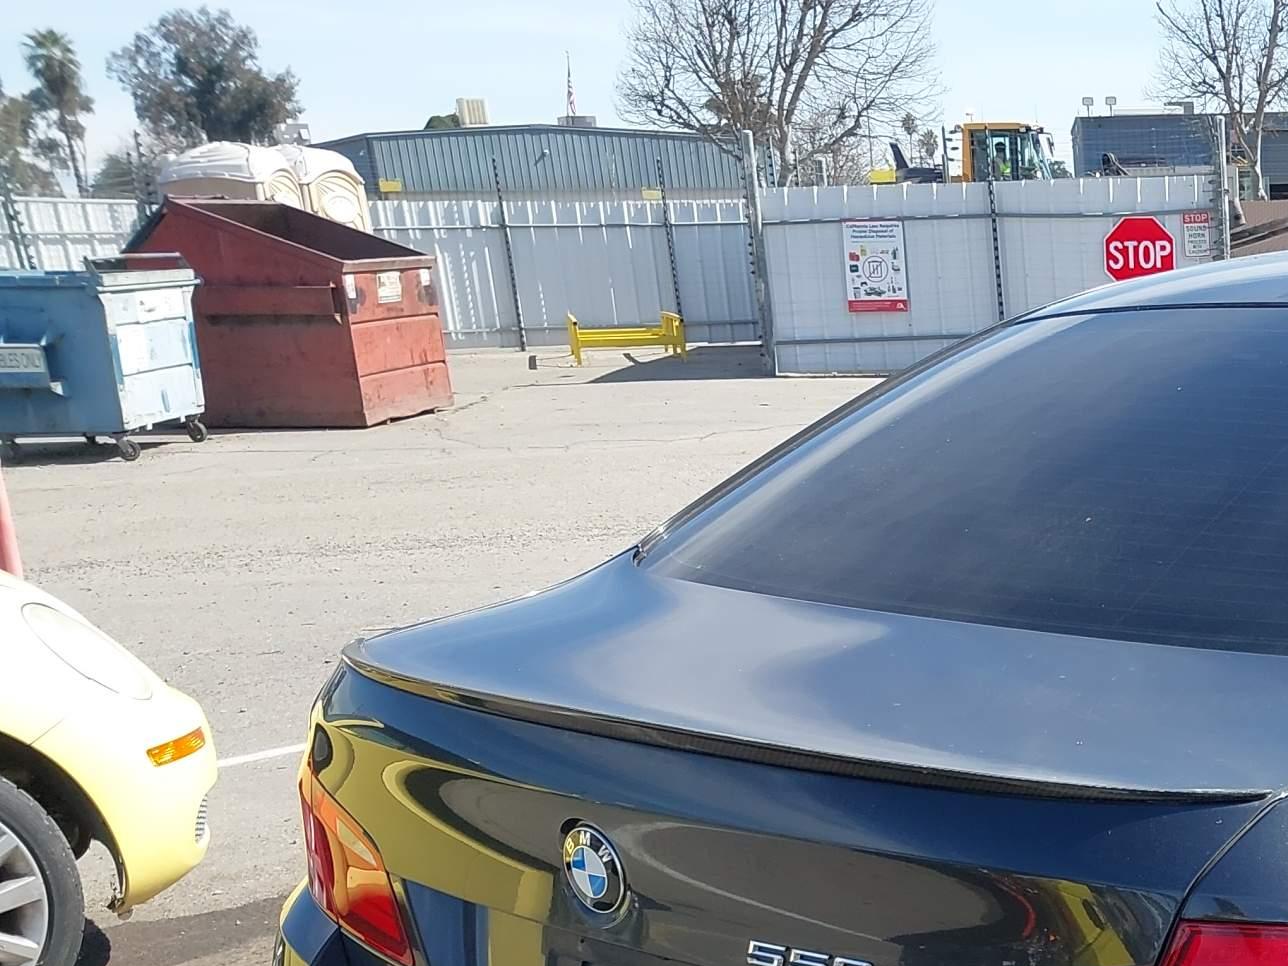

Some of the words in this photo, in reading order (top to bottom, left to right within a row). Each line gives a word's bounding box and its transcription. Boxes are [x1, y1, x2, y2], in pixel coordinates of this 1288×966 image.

[1184, 213, 1208, 223] STOP
[1108, 240, 1171, 270] STOP
[565, 830, 613, 863] BMW
